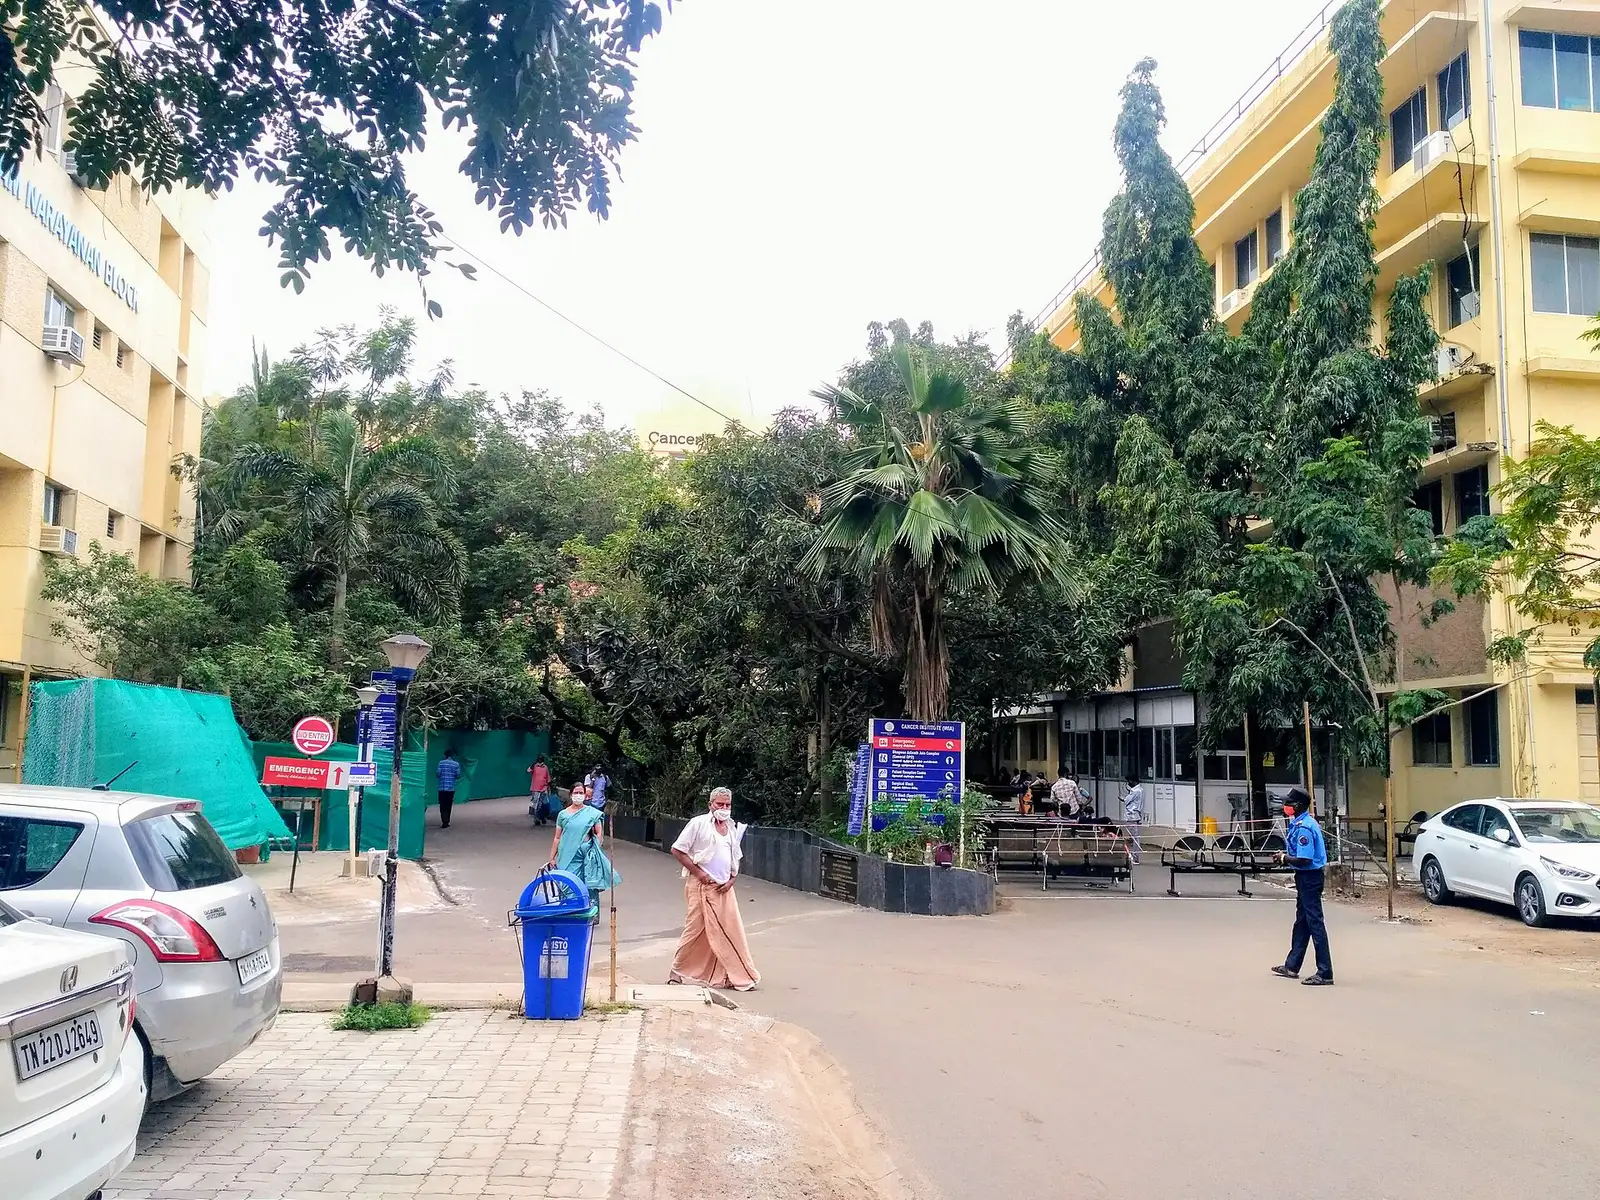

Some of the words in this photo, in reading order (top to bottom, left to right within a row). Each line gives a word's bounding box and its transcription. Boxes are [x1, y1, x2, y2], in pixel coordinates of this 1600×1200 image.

[25, 180, 101, 277] NARAYANAN
[104, 260, 139, 313] BLOCK
[308, 732, 329, 740] ENTRY
[269, 764, 326, 775] EMERGENCY
[542, 940, 568, 950] AISTO
